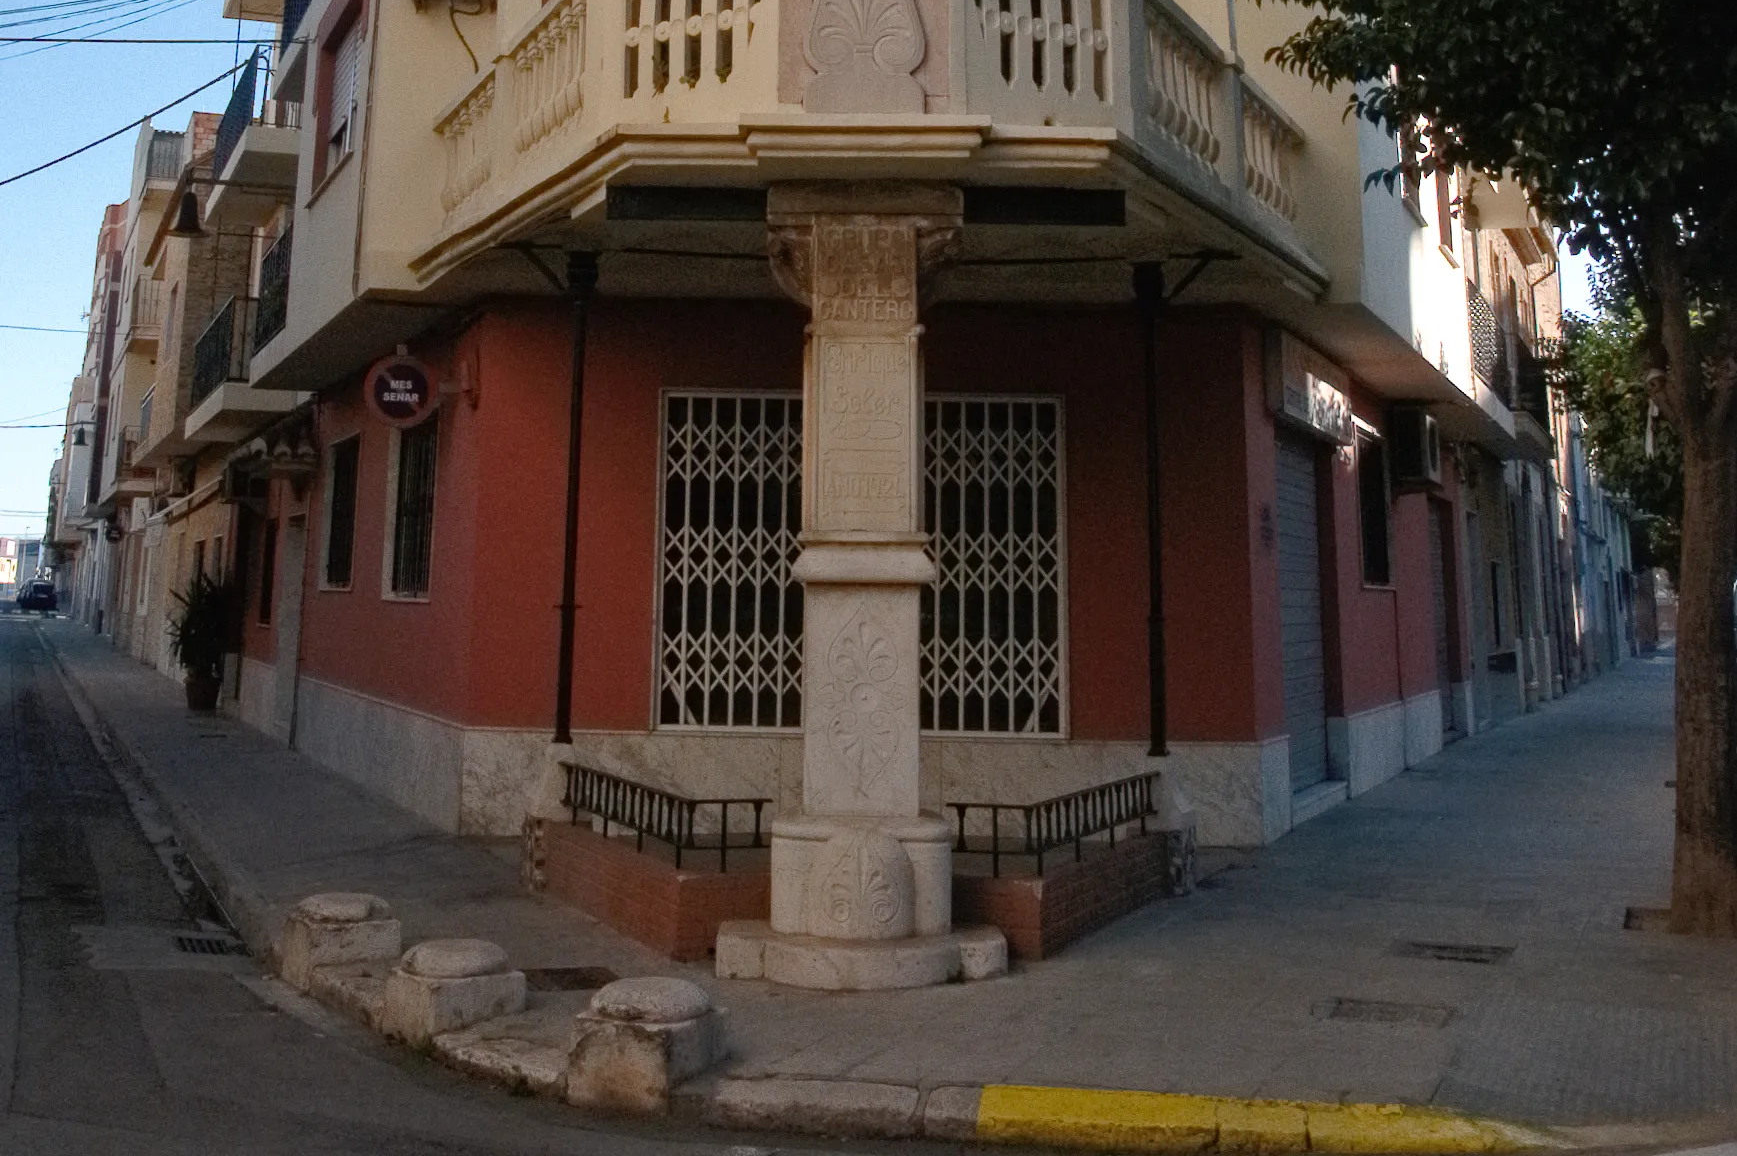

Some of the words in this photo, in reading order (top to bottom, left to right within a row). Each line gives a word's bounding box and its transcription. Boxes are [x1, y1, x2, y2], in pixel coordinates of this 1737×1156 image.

[818, 299, 915, 322] CANTERO
[826, 343, 908, 386] Enrique
[390, 380, 412, 390] MES
[383, 392, 419, 403] SENAR
[832, 385, 900, 415] Soler
